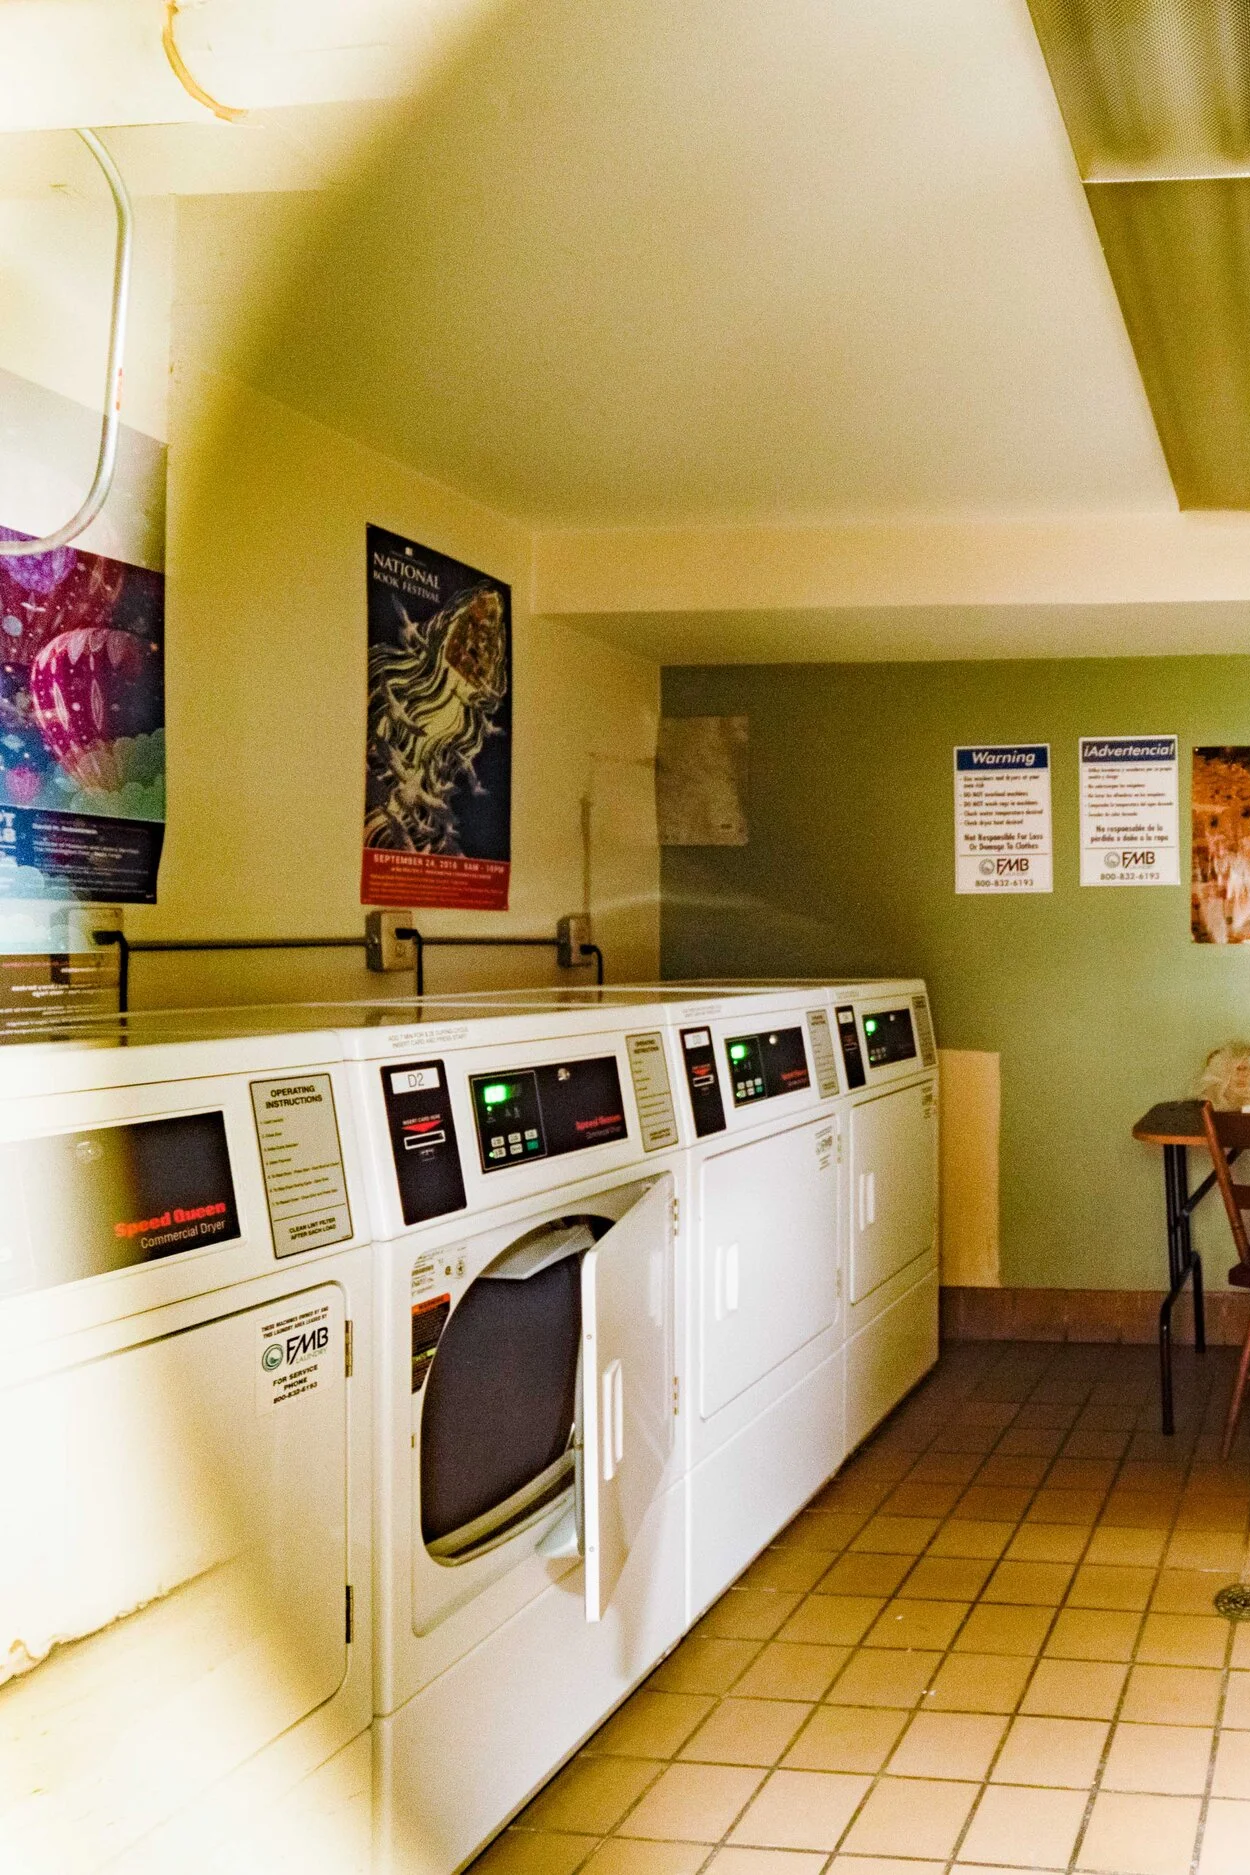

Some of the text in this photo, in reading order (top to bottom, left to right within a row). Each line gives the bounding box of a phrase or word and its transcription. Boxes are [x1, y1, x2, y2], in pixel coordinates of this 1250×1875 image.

[373, 551, 440, 590] NATIONAL
[373, 569, 440, 603] BOOK FESTIVAL
[972, 750, 1036, 767] Warning
[1107, 824, 1145, 833] responsable
[978, 833, 1015, 842] Responsible
[1018, 832, 1027, 840] For
[1029, 832, 1043, 840] Loss
[969, 841, 1039, 852] Or Damage To Clothes
[373, 854, 423, 865] SEPTEMBER
[996, 858, 1029, 875] FMB
[1122, 852, 1155, 869] FMB
[975, 879, 1034, 887] 800-832-6193
[1100, 872, 1160, 881] 800-832-6193
[407, 1072, 424, 1087] D2
[270, 1085, 315, 1098] OPERATING
[265, 1094, 323, 1109] INSTRUCTIONS
[575, 1119, 599, 1131] Speed
[113, 1202, 227, 1238] Speed Queen
[288, 1225, 307, 1233] CLEAN
[319, 1217, 336, 1225] FILTER
[140, 1218, 226, 1249] Commercial Dryer
[291, 1224, 336, 1240] AFTER EACH LOAD
[261, 1323, 275, 1332] THESE
[276, 1316, 298, 1327] MACHINES
[299, 1310, 314, 1319] OWNED
[263, 1331, 273, 1339] THIS
[274, 1325, 293, 1335] LAUNDRY
[286, 1327, 329, 1365] FMB
[296, 1349, 328, 1364] LAUNDRY
[273, 1364, 319, 1386] FOR SERVICE
[283, 1377, 308, 1390] PHONE
[273, 1382, 318, 1404] 800-832-6193
